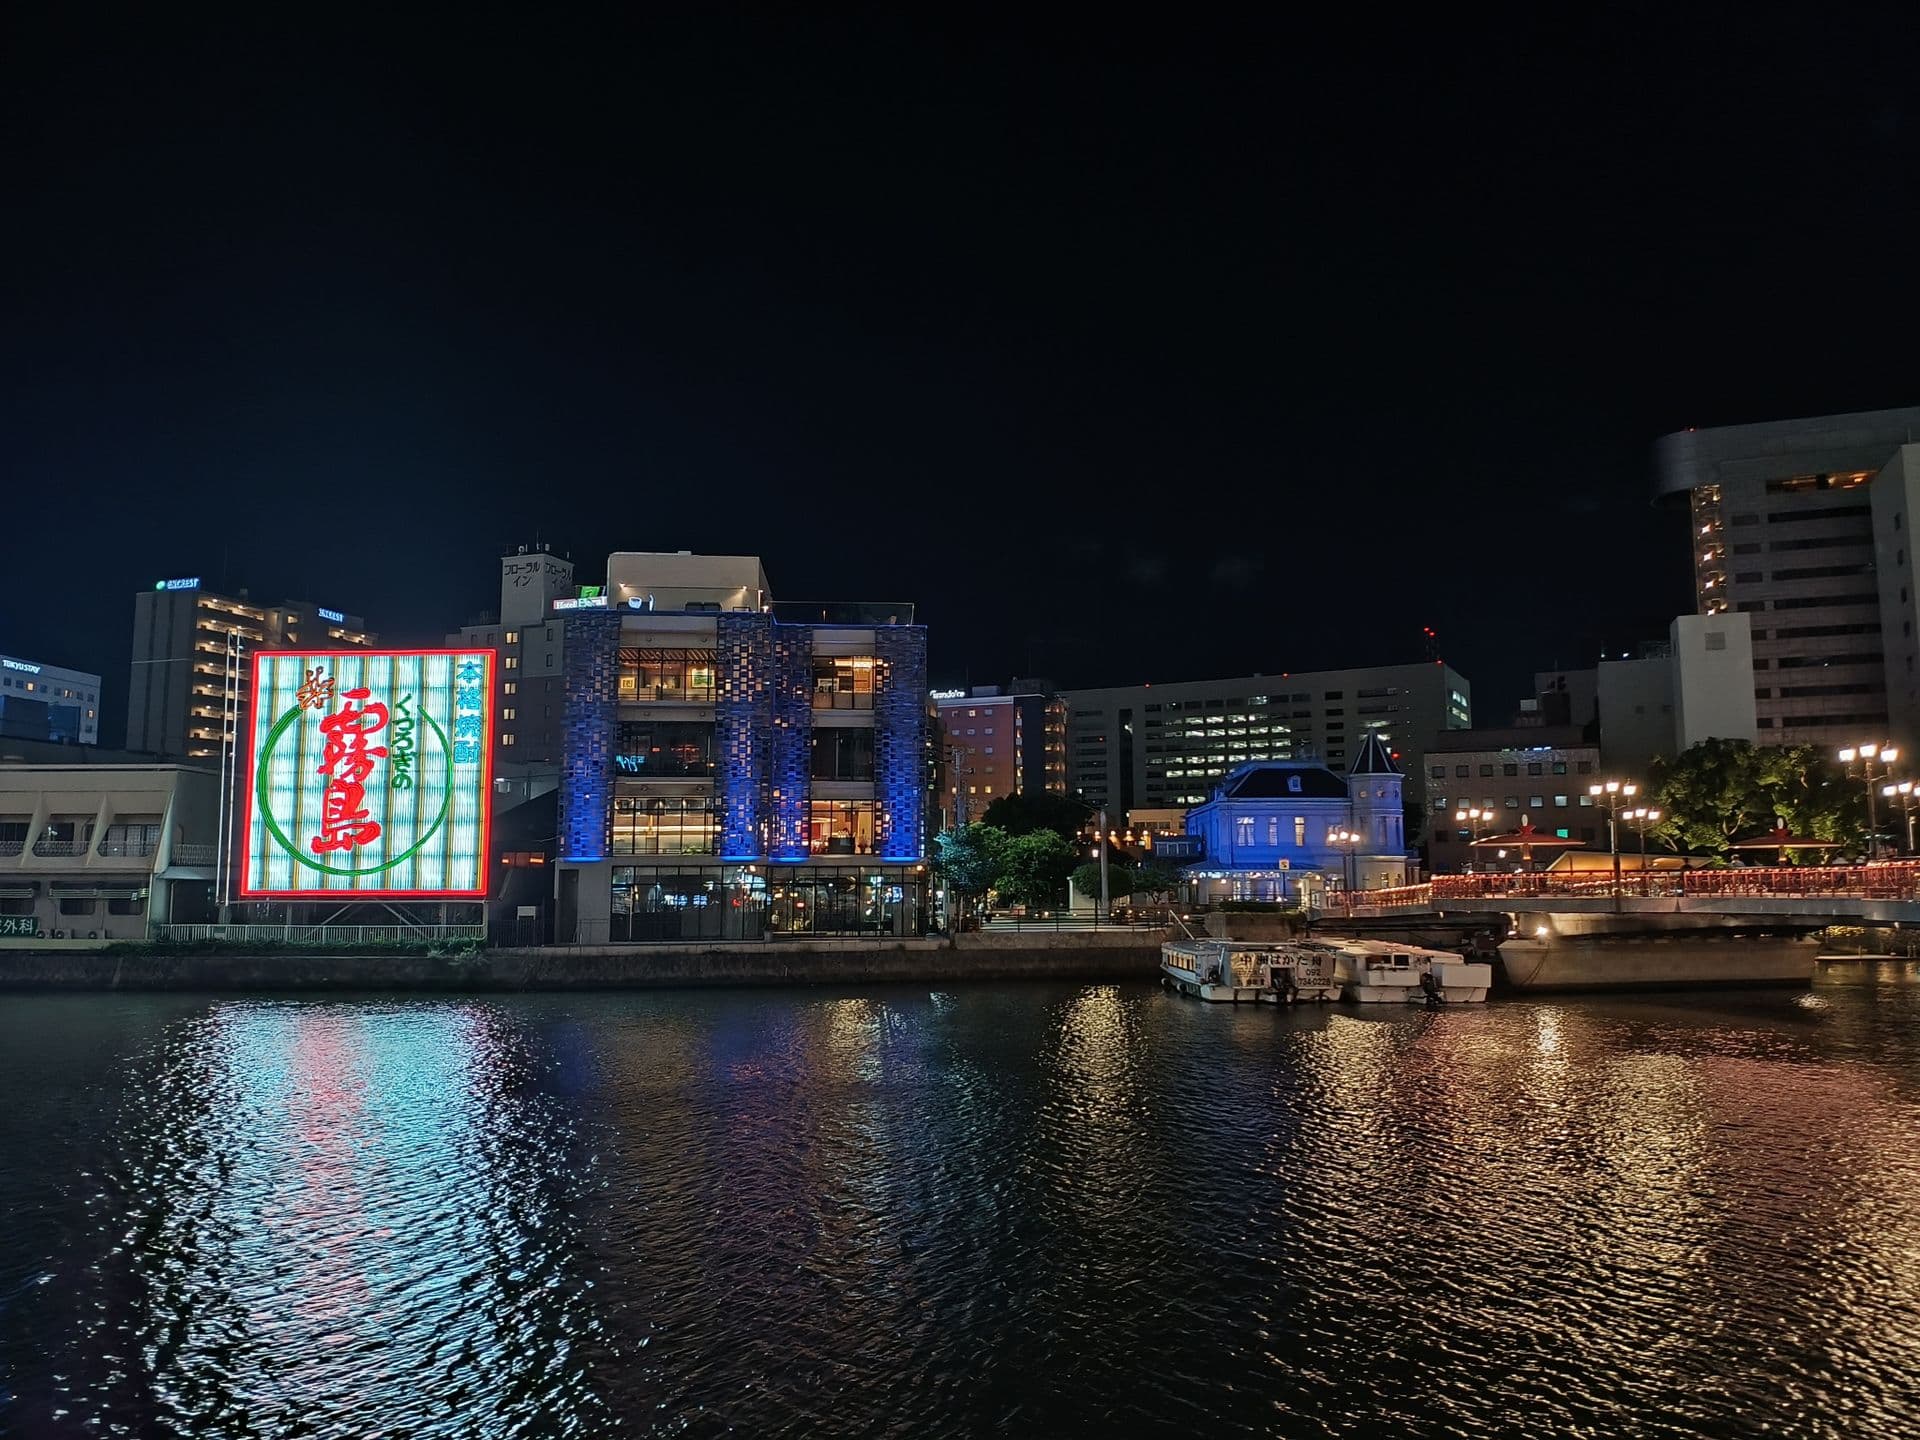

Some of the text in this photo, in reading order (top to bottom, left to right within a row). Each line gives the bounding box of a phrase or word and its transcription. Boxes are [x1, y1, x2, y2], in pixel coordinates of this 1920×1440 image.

[504, 561, 540, 576] フローラル
[513, 575, 532, 588] イン
[453, 660, 483, 764] 本格焼酎
[310, 687, 391, 854] 霧島
[1306, 968, 1321, 976] 092
